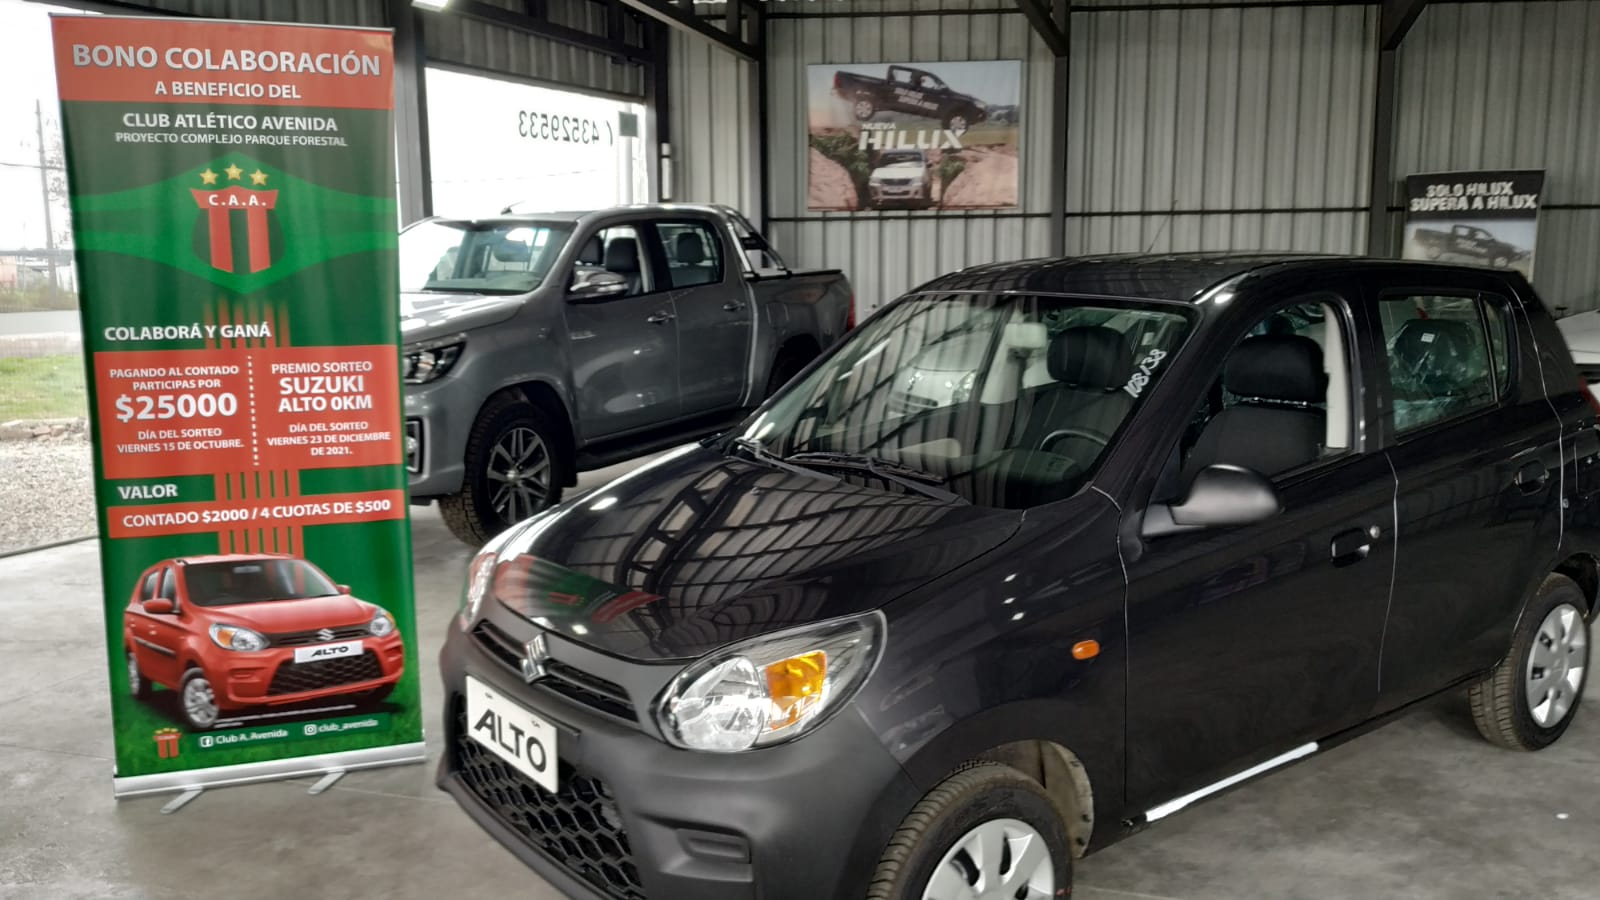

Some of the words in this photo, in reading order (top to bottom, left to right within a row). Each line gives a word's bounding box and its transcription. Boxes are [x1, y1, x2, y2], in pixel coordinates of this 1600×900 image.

[72, 44, 158, 68] BONO
[165, 48, 380, 76] COLABORACIÓN
[155, 81, 168, 95] A
[172, 81, 264, 97] BENEFICIO
[269, 84, 301, 98] DEL
[123, 113, 170, 128] CLUB
[175, 112, 257, 129] ATLÉTICO
[262, 116, 338, 131] AVENIDA
[115, 132, 178, 143] PROYECTO
[181, 133, 242, 144] COMPLEJO
[245, 135, 291, 146] PARQUE
[292, 136, 348, 146] FORESTAL
[858, 129, 966, 150] HILUX
[1466, 181, 1514, 196] HILUX
[208, 193, 267, 206] C.A.A.
[1410, 197, 1469, 212] SUPERA
[1471, 197, 1484, 210] A
[1487, 194, 1538, 209] HILUX
[104, 323, 203, 340] COLABORÁ
[205, 325, 216, 339] Y
[220, 322, 271, 339] GANÁ
[110, 368, 166, 378] PAGANDO
[168, 367, 182, 376] AL
[185, 366, 239, 376] CONTADO
[271, 362, 320, 374] PREMIO
[323, 361, 372, 372] SORTEO
[132, 380, 196, 390] PARTICIPAS
[198, 379, 221, 388] POR
[280, 375, 364, 395] SUZUKI
[115, 392, 238, 423] $25000
[278, 396, 326, 413] ALTO
[138, 429, 156, 440] DÍA
[159, 429, 179, 439] DEL
[181, 428, 222, 437] SORTEO
[289, 423, 307, 433] DÍA
[309, 423, 328, 432] DEL
[329, 421, 368, 431] SORTEO
[117, 443, 160, 453] VIERNES
[164, 442, 175, 451] 15
[177, 441, 192, 450] DE
[194, 439, 244, 449] OCTUBRE.
[267, 436, 308, 446] VIERNES
[310, 435, 322, 444] 23
[324, 435, 336, 443] DE
[338, 432, 391, 442] DICIEMBRE
[311, 447, 324, 456] DE
[326, 446, 352, 455] 2021.
[117, 484, 178, 499] VALOR
[123, 512, 199, 528] CONTADO
[202, 508, 249, 524] $2000
[260, 508, 270, 518] 4
[272, 503, 330, 518] CUOTAS
[333, 502, 353, 514] DE
[355, 500, 390, 514] $500
[310, 645, 349, 657] ALTO
[318, 719, 378, 732] club_avenida
[216, 734, 238, 744] Club
[250, 729, 288, 740] Avenida
[474, 709, 546, 772] ALTO
